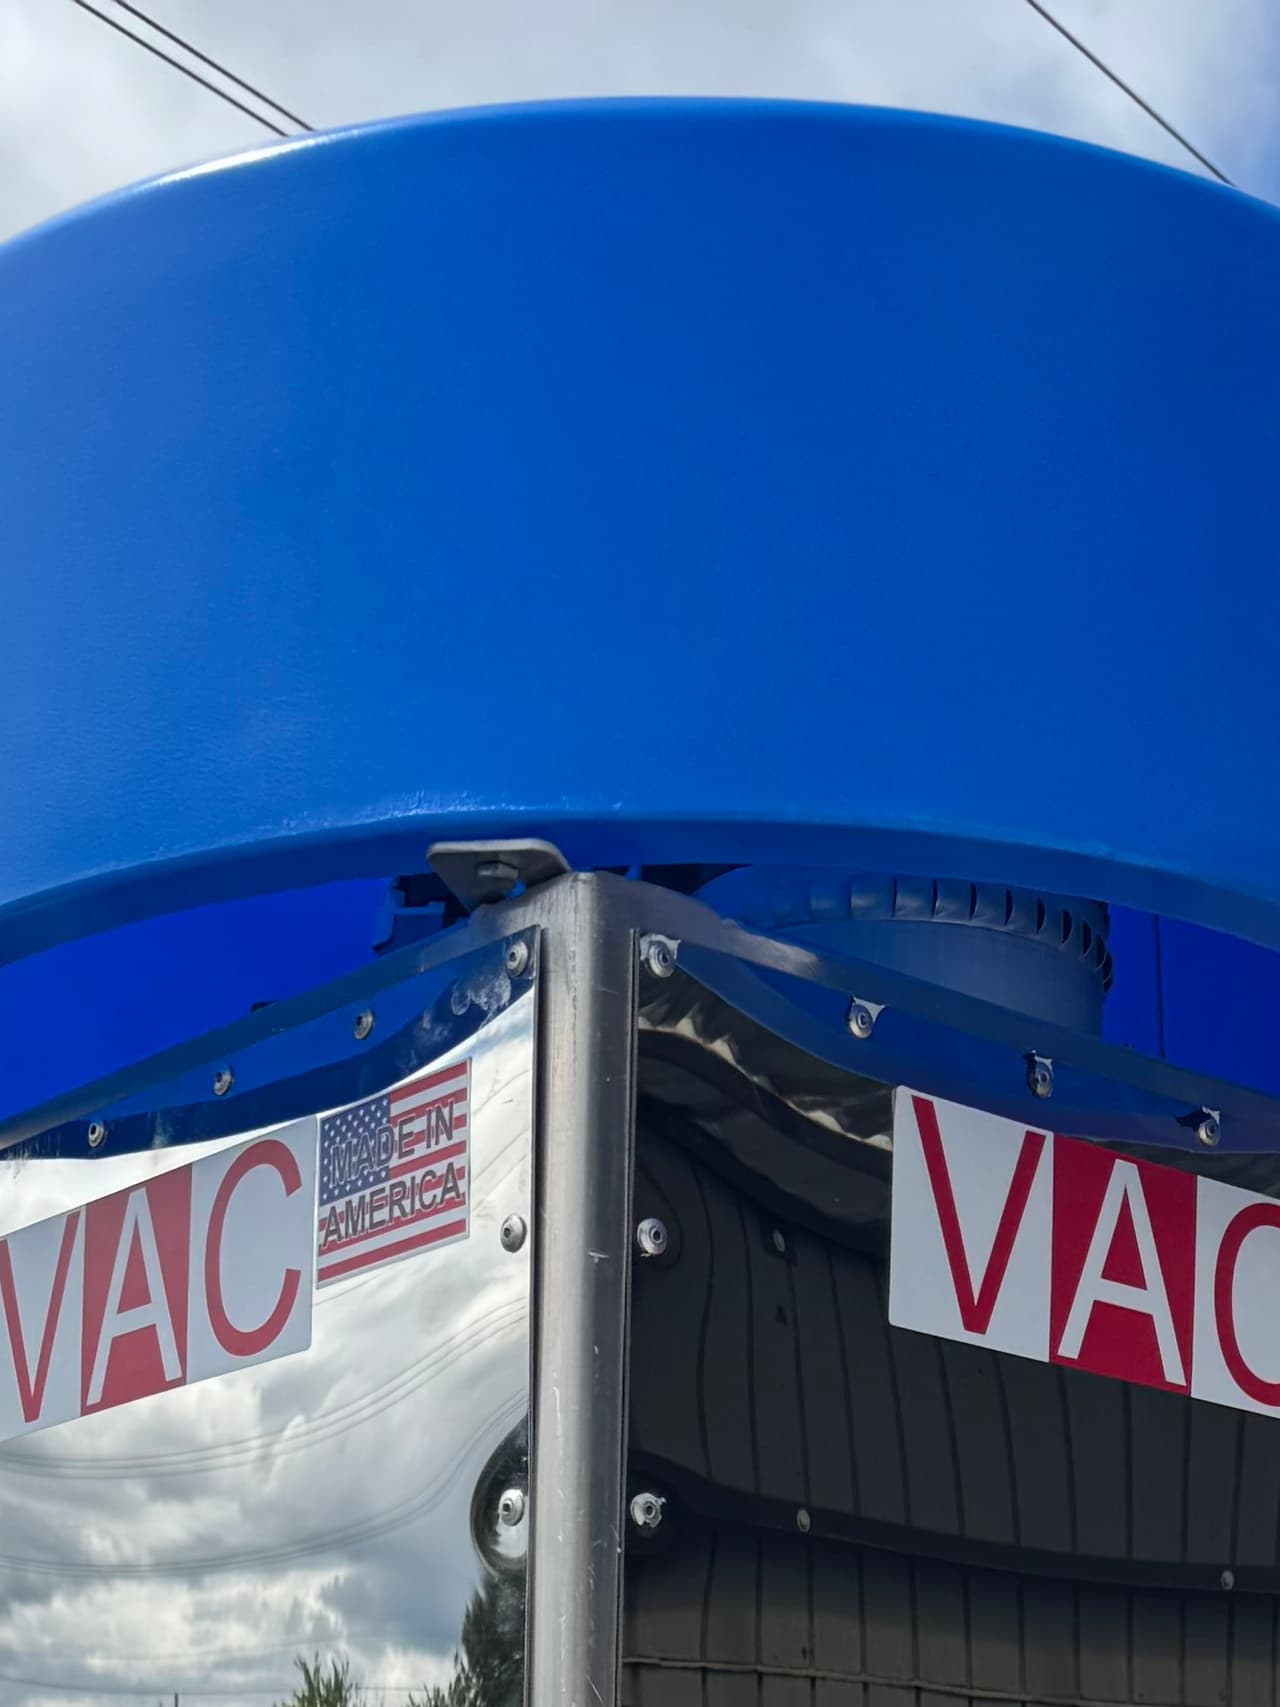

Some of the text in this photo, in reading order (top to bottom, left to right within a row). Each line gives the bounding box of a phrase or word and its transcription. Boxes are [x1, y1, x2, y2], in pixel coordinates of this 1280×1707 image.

[329, 1099, 455, 1188] MADE IN
[322, 1161, 461, 1246] AMERICA
